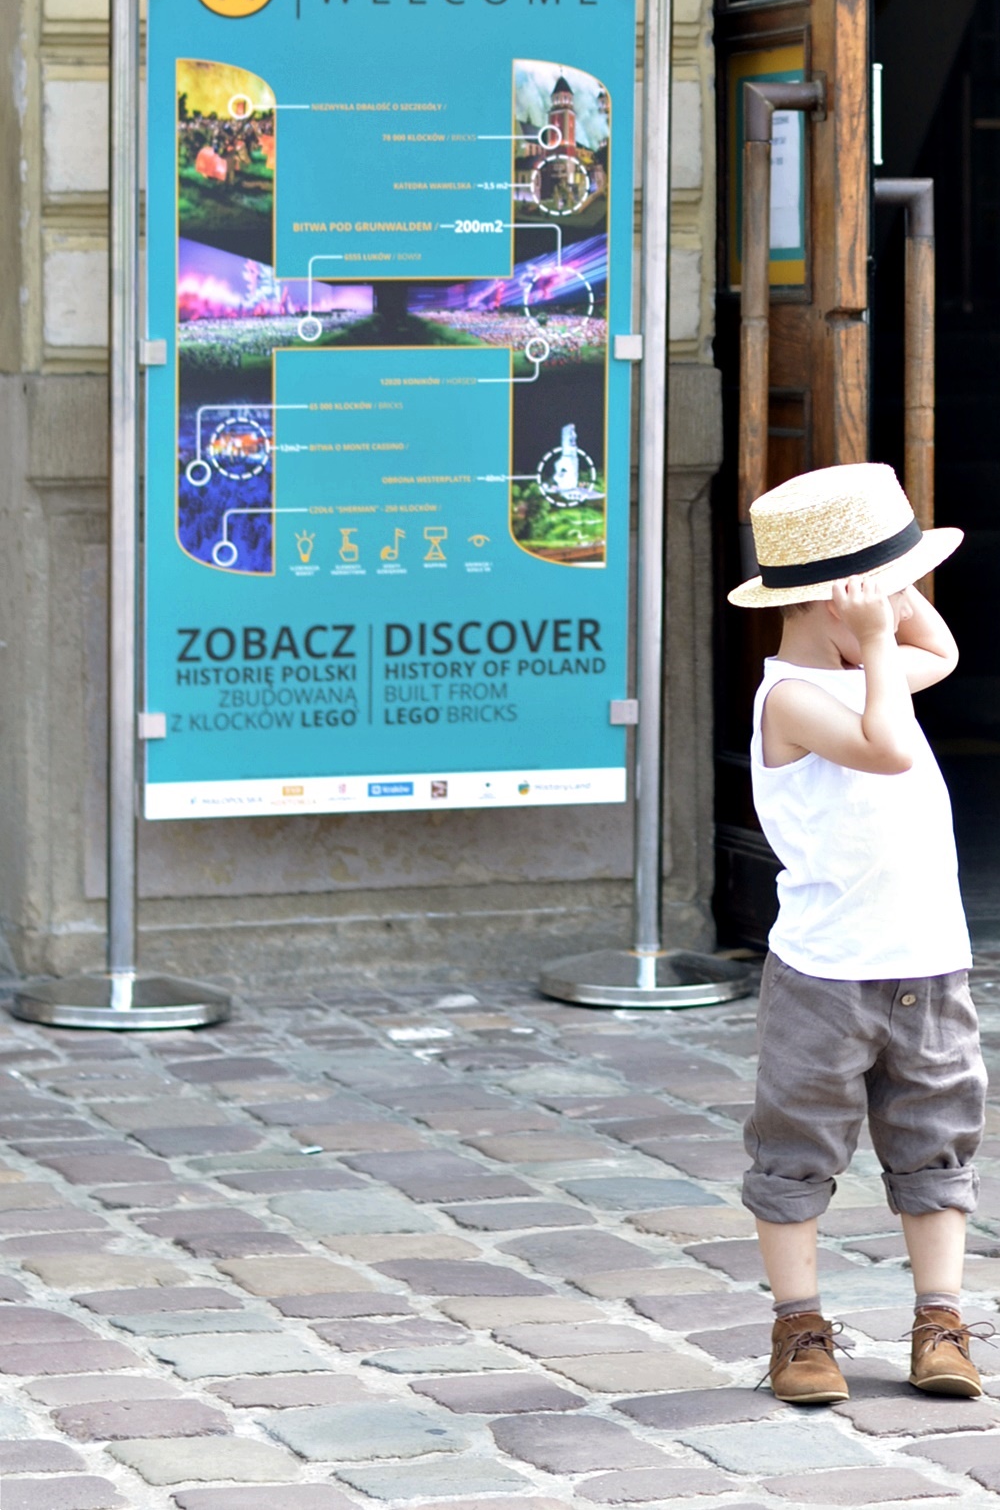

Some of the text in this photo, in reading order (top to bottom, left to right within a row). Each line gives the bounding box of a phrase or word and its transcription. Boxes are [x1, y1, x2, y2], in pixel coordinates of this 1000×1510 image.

[293, 222, 327, 233] BITWA
[329, 222, 352, 232] POD
[355, 222, 432, 232] GRUNWALDEM
[454, 220, 504, 233] 200m2
[177, 624, 356, 663] ZOBACZ
[384, 618, 604, 658] DISCOVER
[176, 664, 357, 690] HISTORIĘ POLSKI
[384, 657, 607, 680] HISTORY OF POLAND
[218, 687, 360, 714] ZBUDOWANĄ
[384, 682, 509, 703] BUILT FROM
[170, 705, 357, 733] Z KLOCKÓW LEGO
[384, 703, 518, 726] LEGO BRICKS
